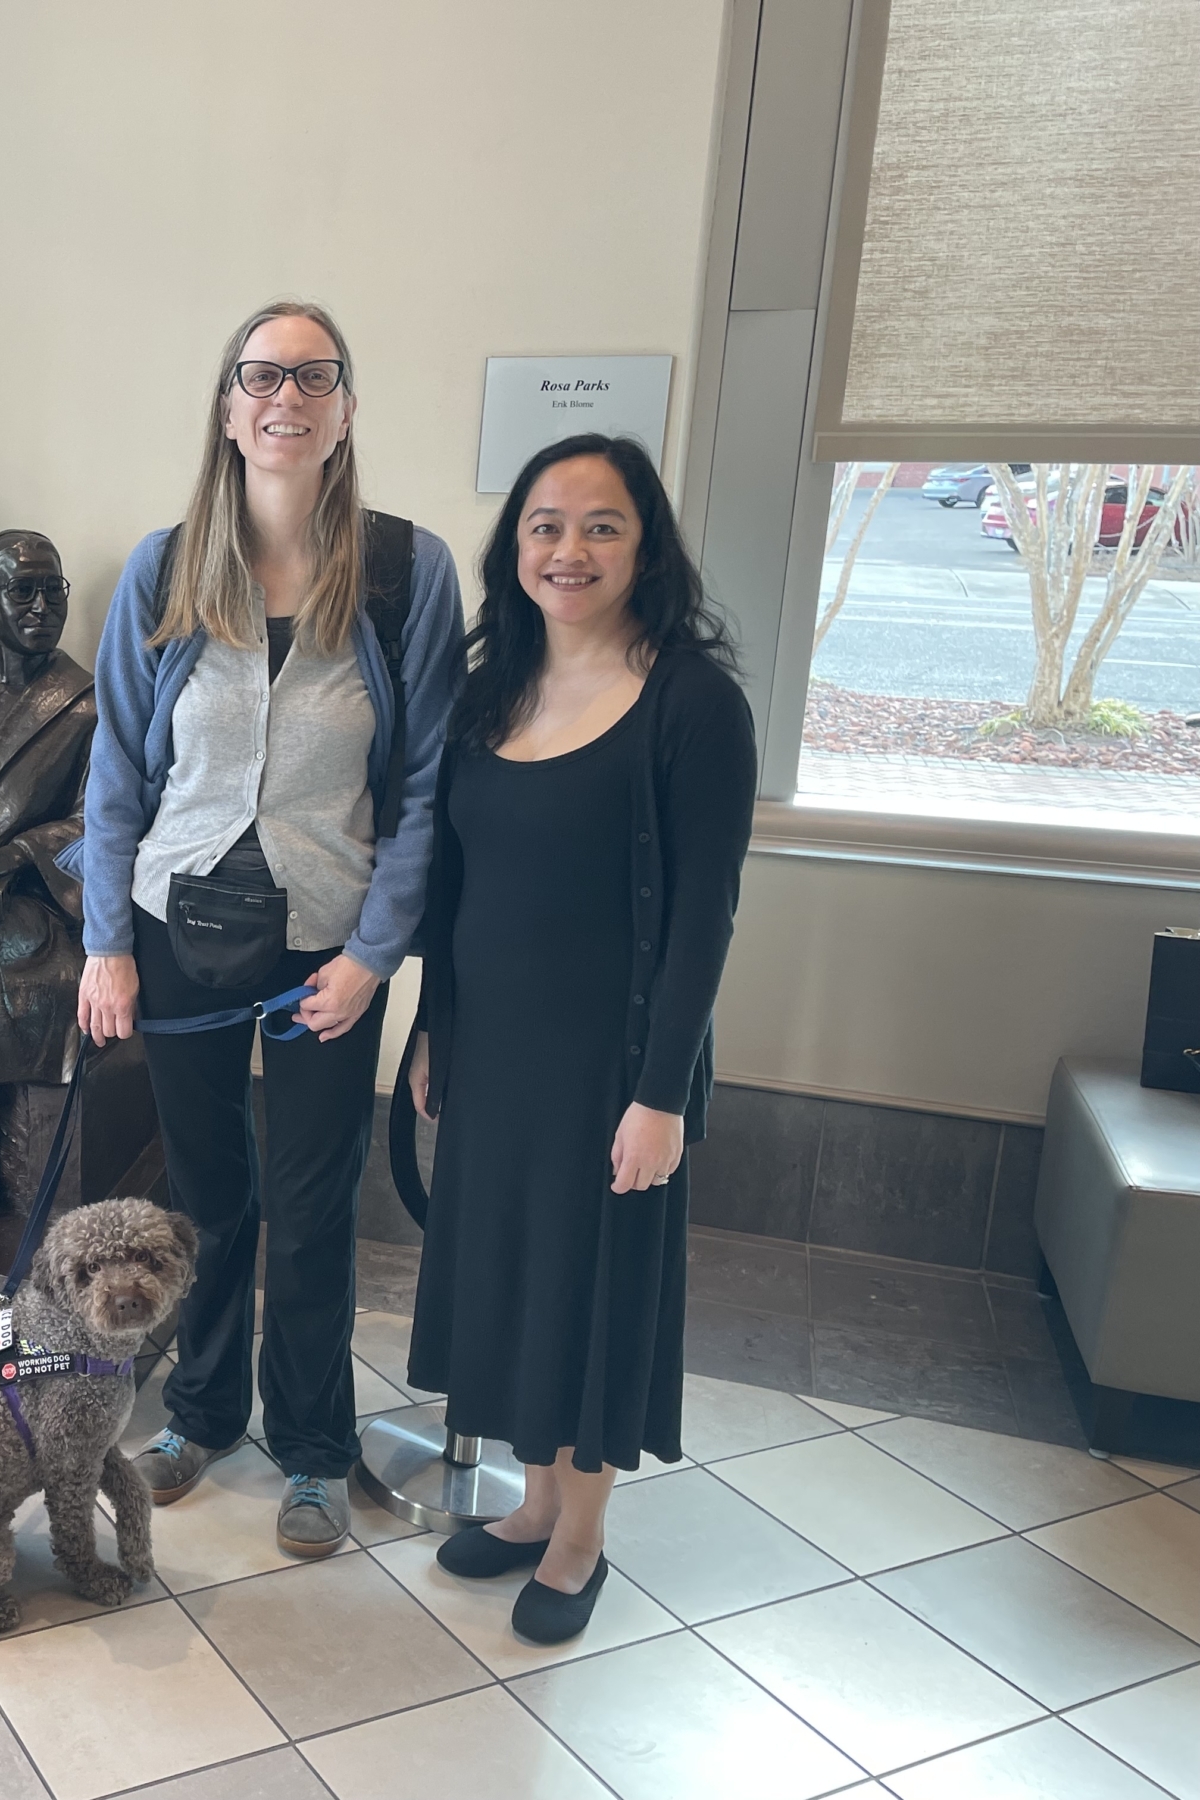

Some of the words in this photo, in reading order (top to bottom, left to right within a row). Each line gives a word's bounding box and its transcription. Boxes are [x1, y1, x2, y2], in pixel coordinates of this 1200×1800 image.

[540, 379, 571, 391] Rosa
[574, 379, 610, 391] Parks
[552, 400, 568, 408] Erik
[1, 1324, 11, 1347] DOG
[18, 1357, 52, 1367] WORKING
[53, 1354, 70, 1363] DOG
[19, 1367, 32, 1376] DO
[34, 1364, 52, 1374] NOT
[54, 1362, 70, 1371] PET
